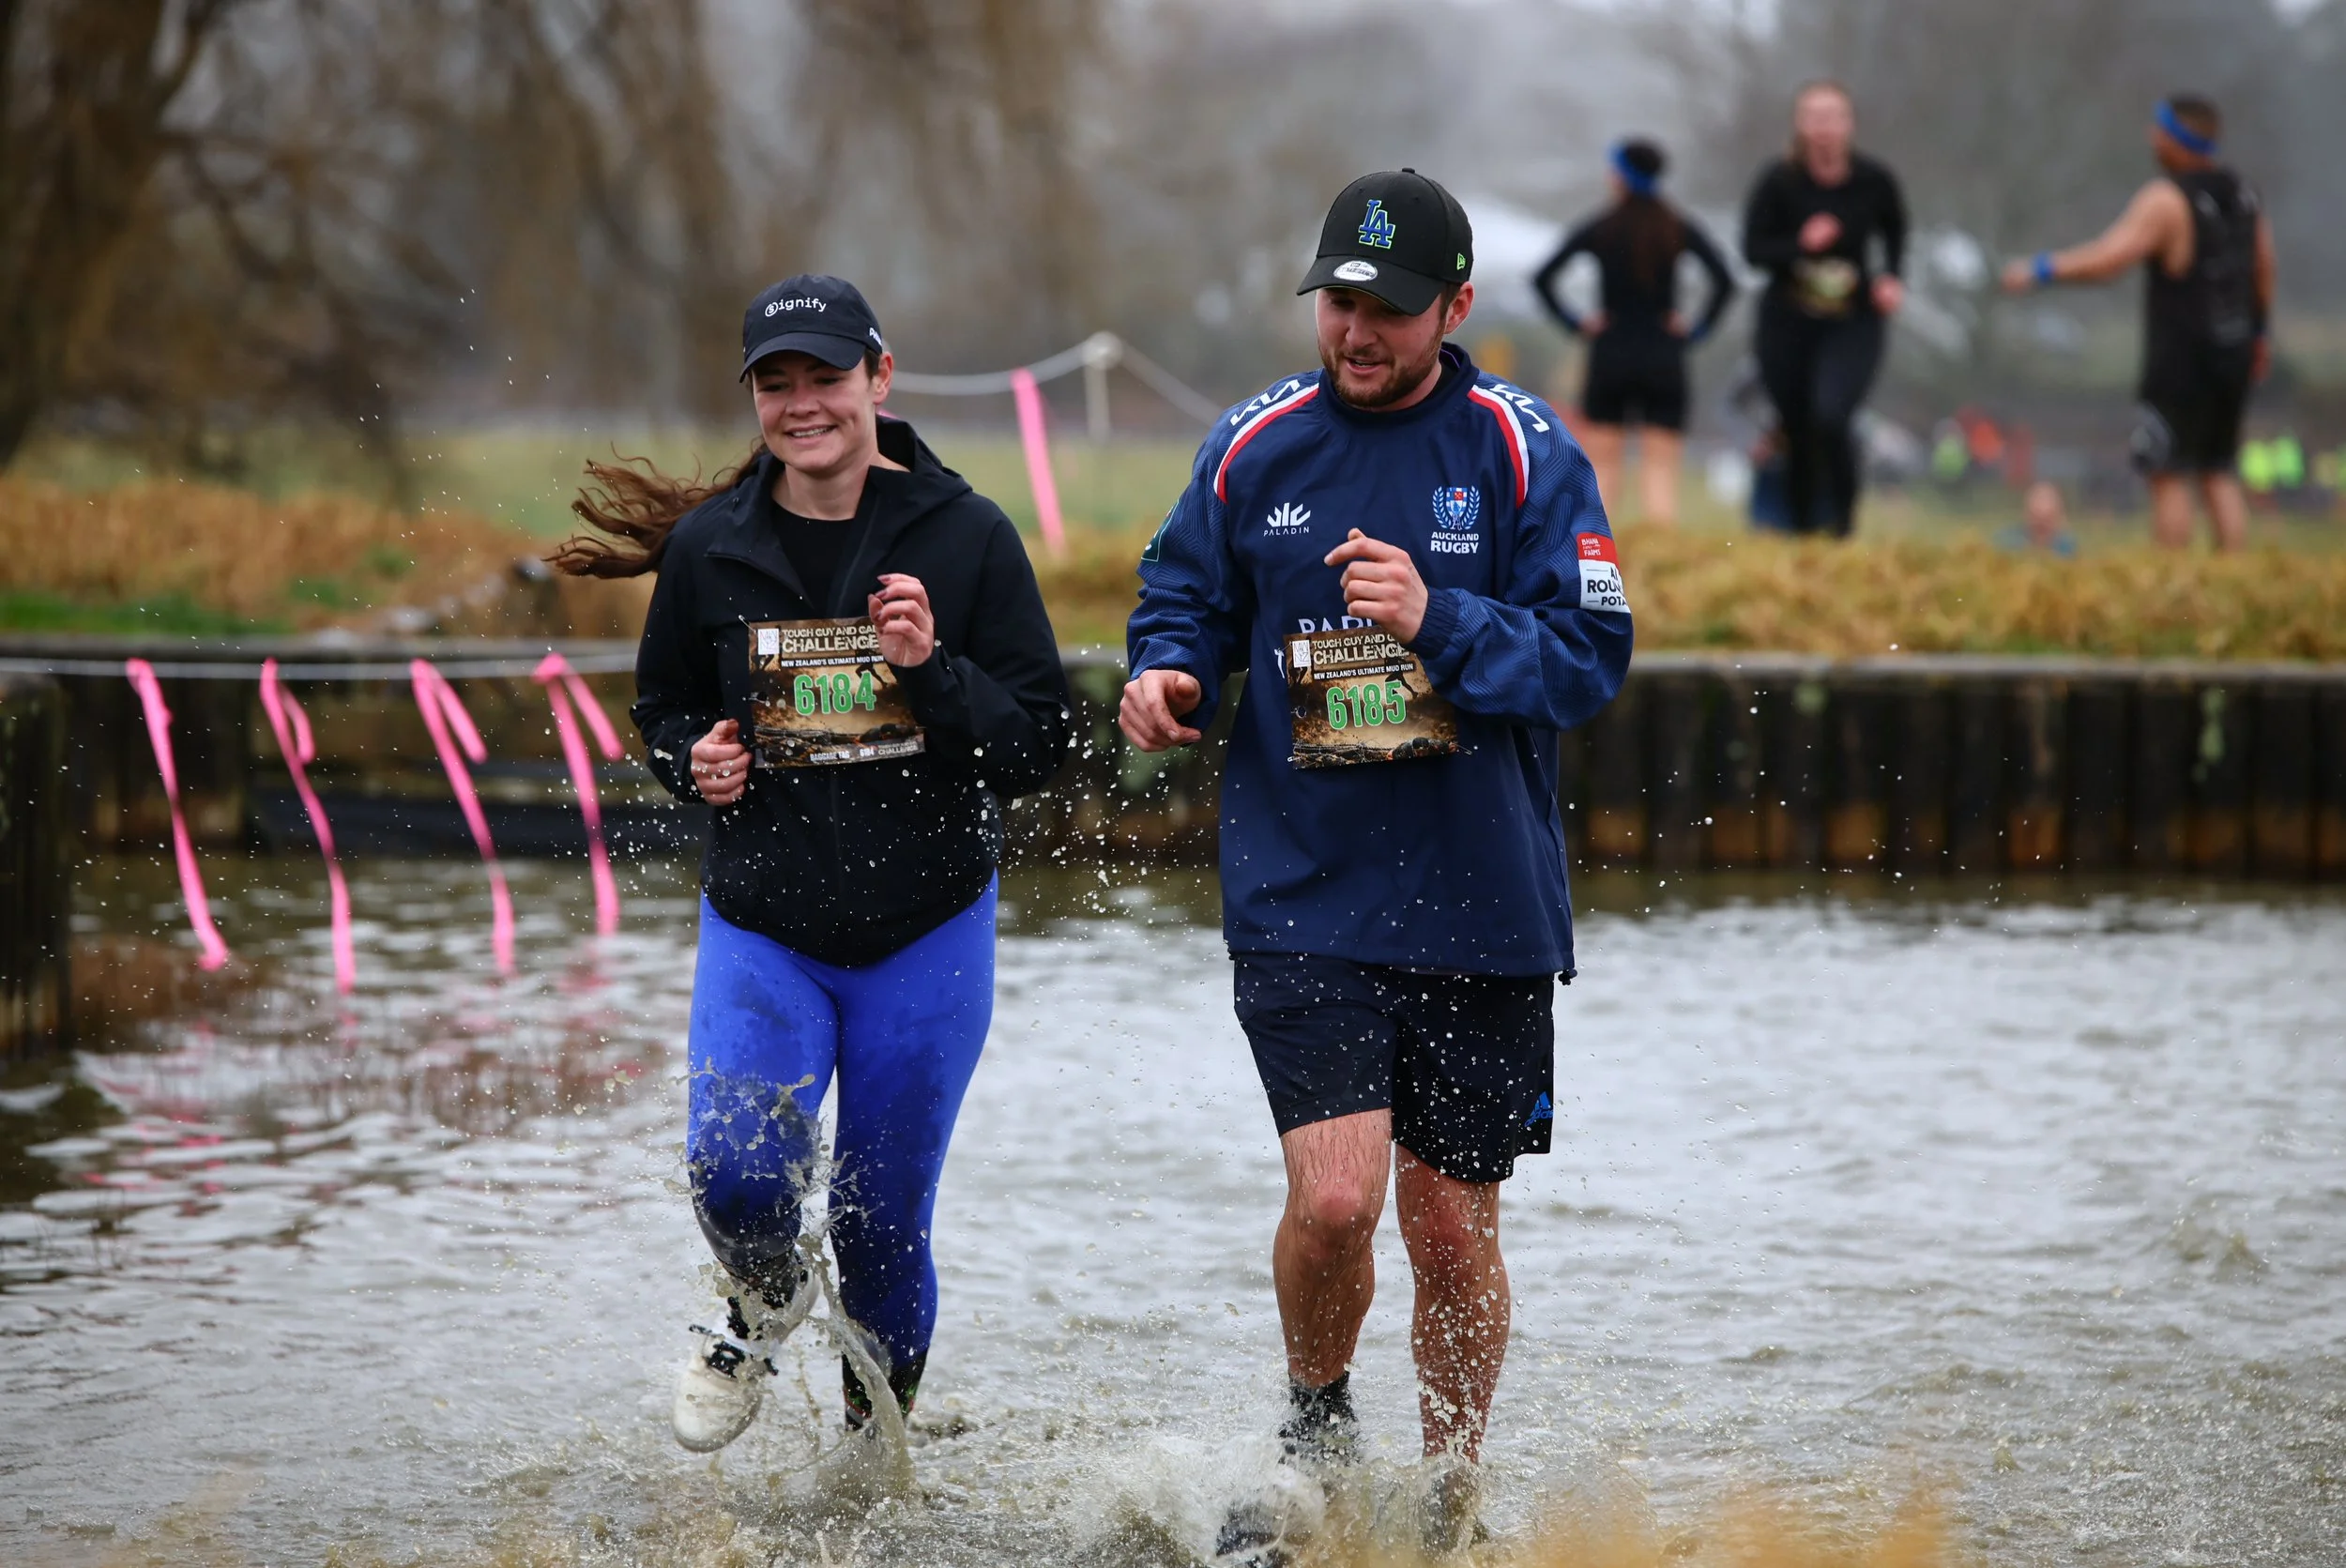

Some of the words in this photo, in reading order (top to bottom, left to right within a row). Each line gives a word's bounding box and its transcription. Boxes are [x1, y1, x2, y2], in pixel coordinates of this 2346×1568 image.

[1358, 199, 1396, 250] LA
[1263, 525, 1310, 538] PALADIN
[1431, 531, 1480, 541] AUCKLAND
[1430, 540, 1480, 554] RUGBY
[782, 628, 814, 638] TOUGH
[815, 627, 834, 637] GUY
[835, 626, 858, 635] AND
[782, 633, 880, 653] CHALLENGE
[1312, 638, 1342, 649] TOUGH
[1343, 635, 1364, 647] GUY
[1363, 633, 1386, 645] AND
[781, 659, 795, 667] NEW
[795, 658, 827, 666] ZEALAND'S
[827, 657, 856, 665] ULTIMATE
[1314, 672, 1326, 680] NEW
[1326, 669, 1357, 679] ZEALAND'S
[1357, 666, 1386, 676] ULTIMATE
[1385, 664, 1401, 673] MUD
[1400, 662, 1414, 671] RUN
[793, 670, 877, 717] 6184
[1326, 679, 1408, 731] 6185
[839, 750, 850, 759] TAG
